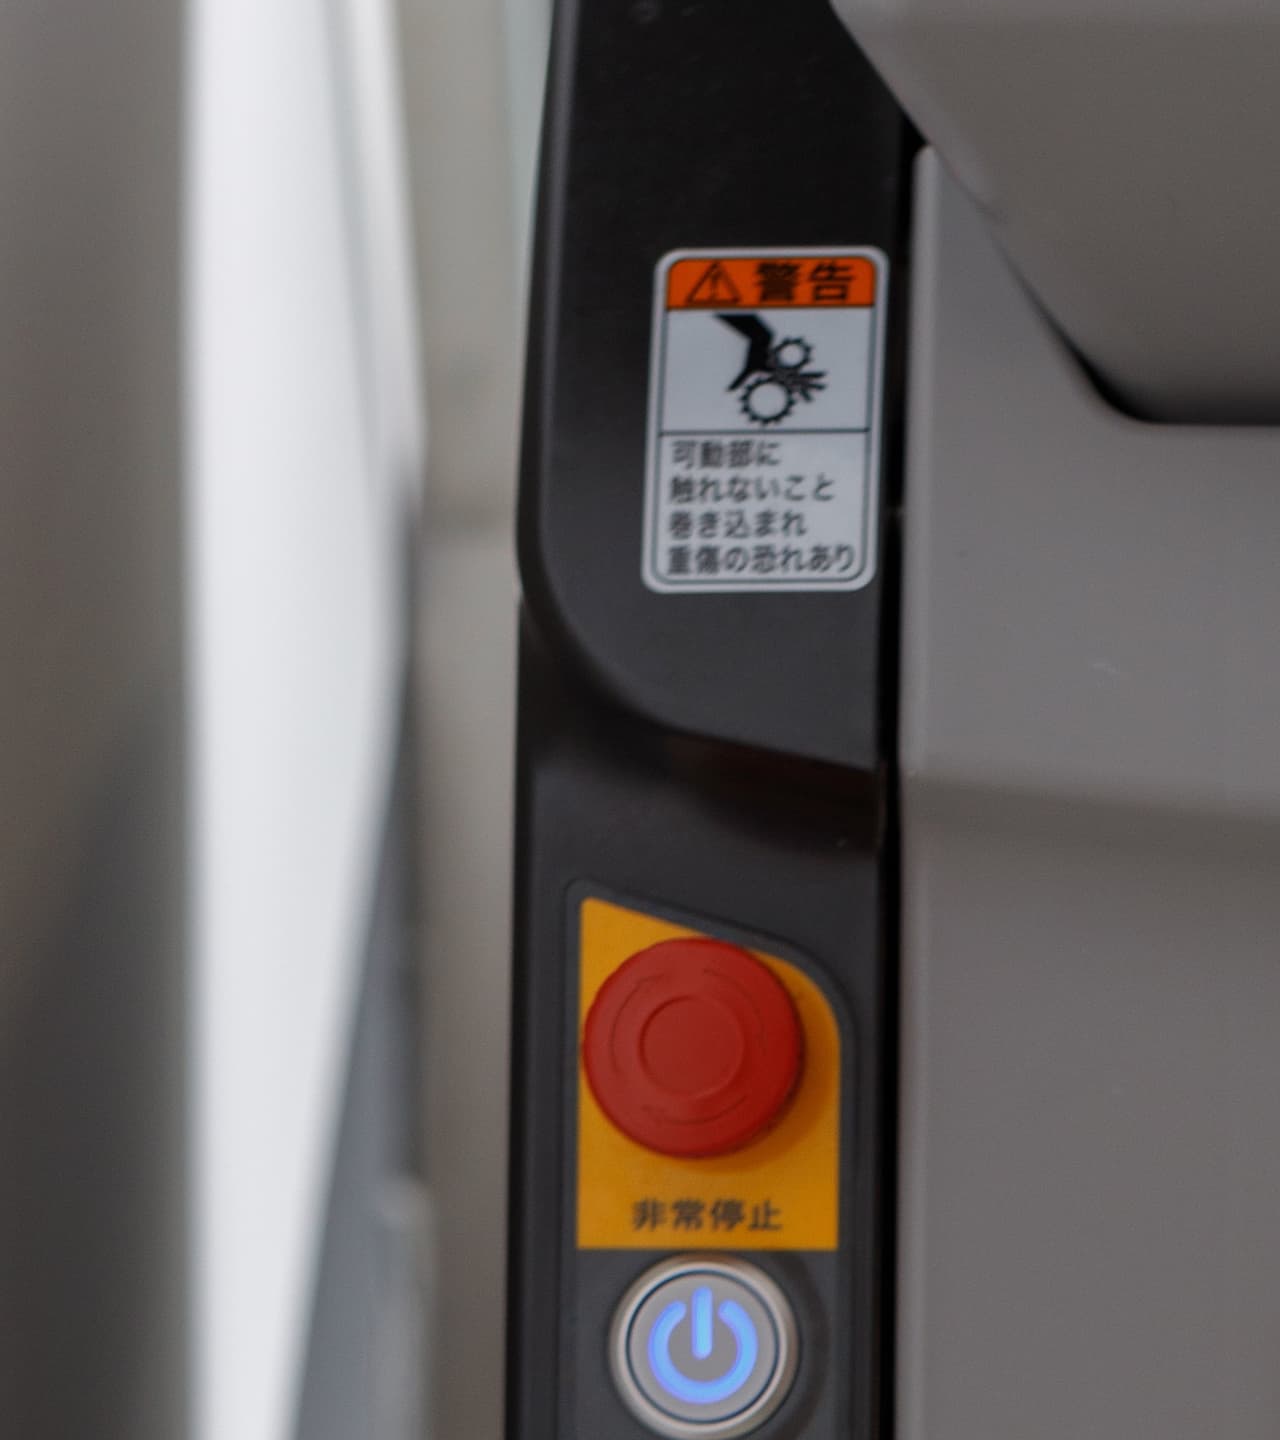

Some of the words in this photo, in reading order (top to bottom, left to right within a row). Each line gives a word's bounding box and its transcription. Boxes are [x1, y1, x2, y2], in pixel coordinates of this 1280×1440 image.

[756, 261, 856, 303] 警告
[670, 440, 782, 470] 可動部に
[631, 1198, 783, 1232] 非常停止
